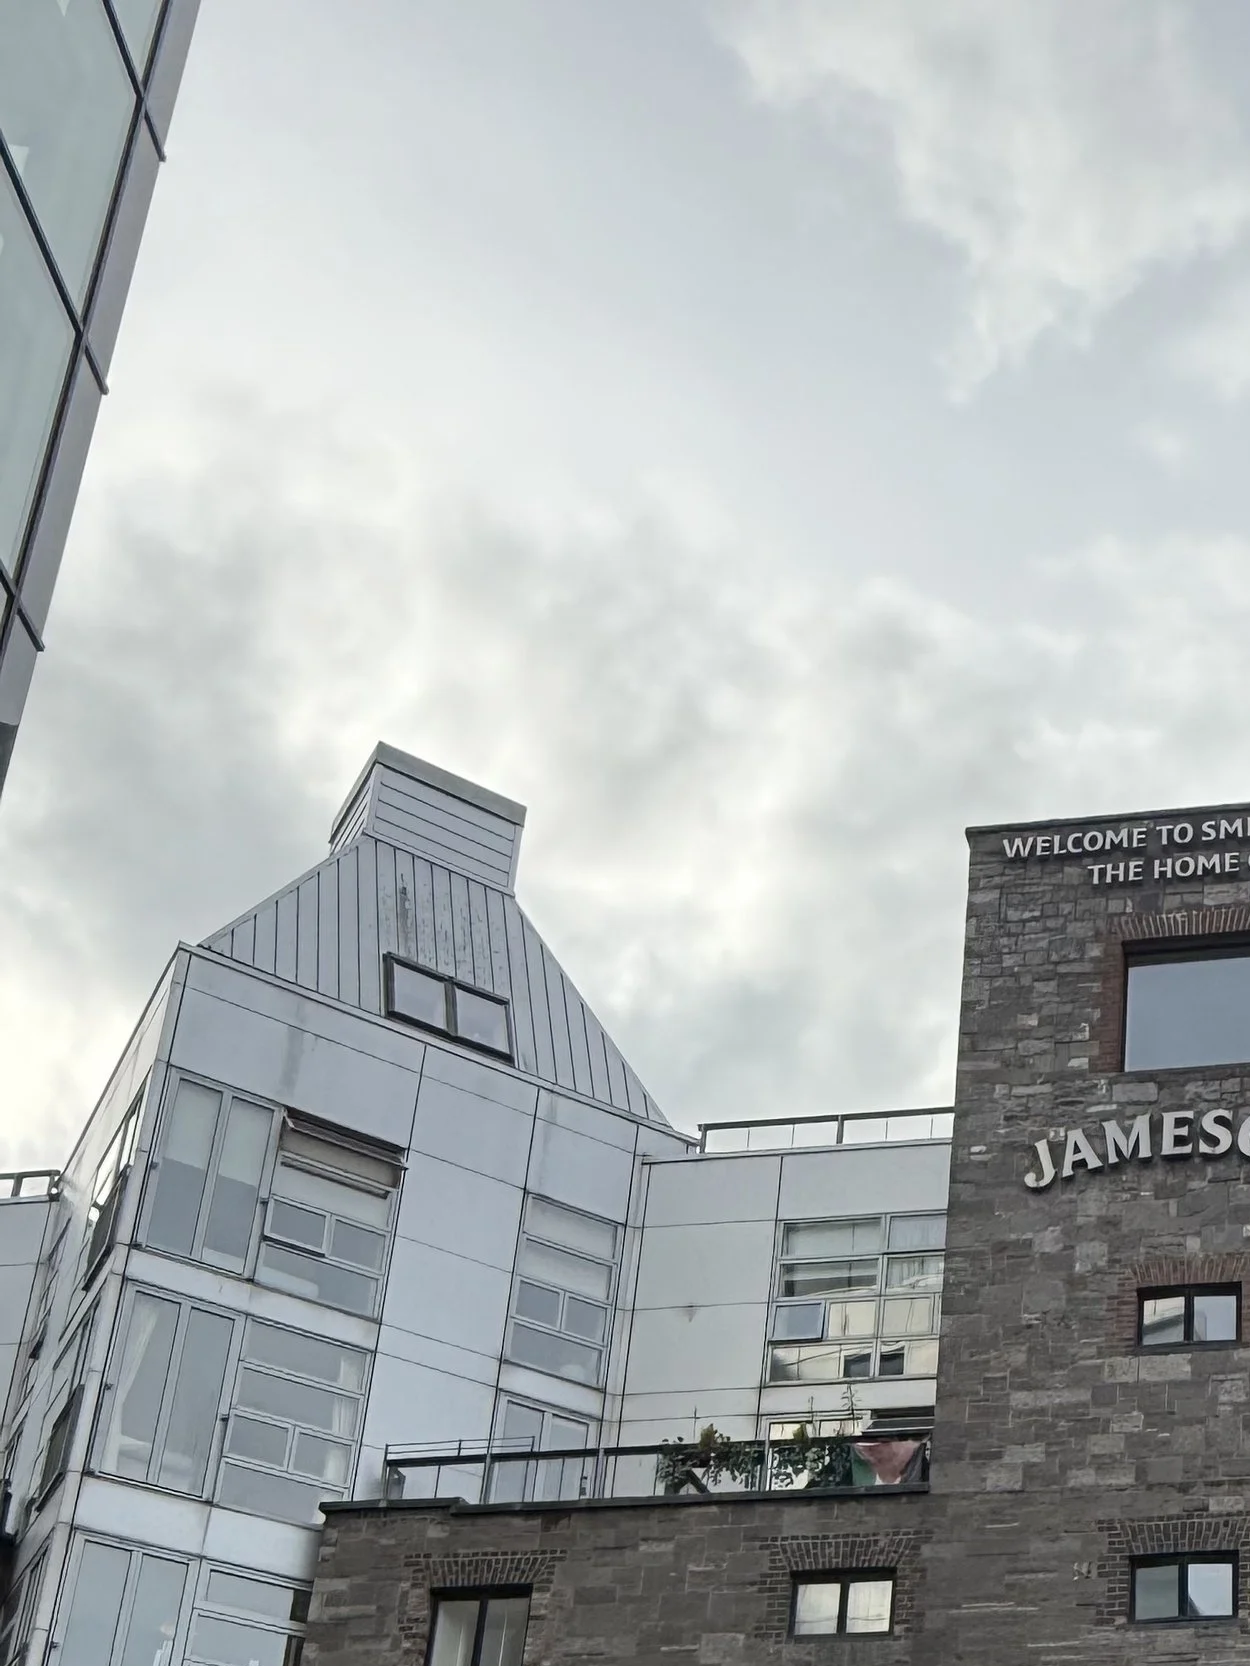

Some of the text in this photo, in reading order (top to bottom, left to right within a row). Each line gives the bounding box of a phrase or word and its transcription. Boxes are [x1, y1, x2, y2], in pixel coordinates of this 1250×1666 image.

[1003, 828, 1147, 859] WELCOME
[1156, 822, 1194, 846] TO
[1088, 861, 1143, 885] THE
[1153, 852, 1240, 880] HOME
